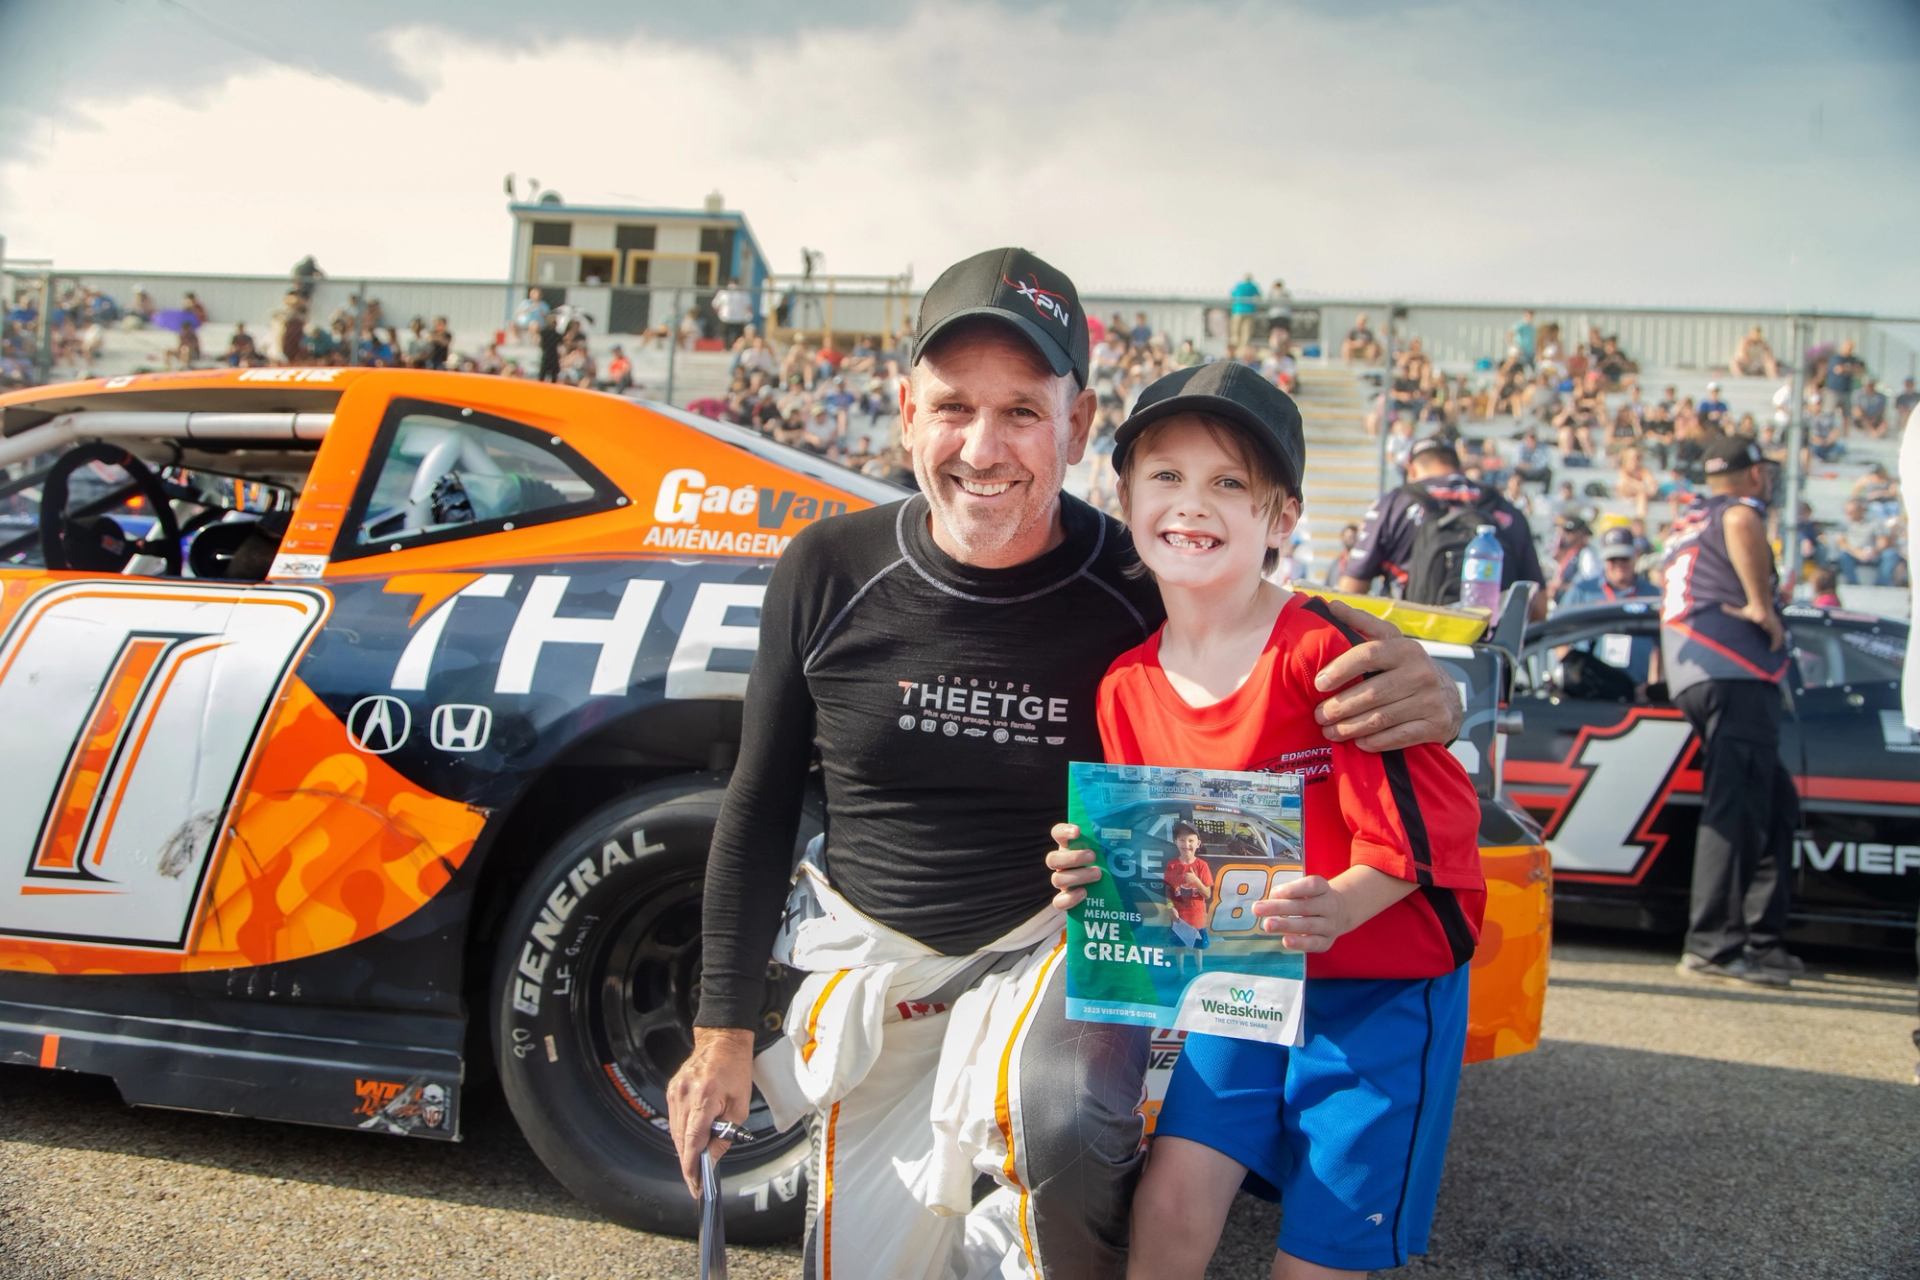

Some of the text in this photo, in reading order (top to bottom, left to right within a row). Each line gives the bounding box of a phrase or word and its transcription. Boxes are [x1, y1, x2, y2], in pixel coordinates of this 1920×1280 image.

[1016, 280, 1069, 327] XPN
[653, 467, 848, 530] GaéVan
[937, 674, 1032, 693] GROUPE
[898, 680, 1069, 723] THEETGE
[1014, 734, 1039, 744] GMC
[1543, 717, 1693, 874] 1
[1086, 897, 1105, 908] THE
[513, 829, 666, 1017] GENERAL
[1084, 909, 1142, 922] MEMORIES
[1084, 920, 1120, 941] WE
[1083, 941, 1172, 968] CREATE.
[1201, 998, 1284, 1022] Wetaskiwin
[1147, 1051, 1180, 1070] VE
